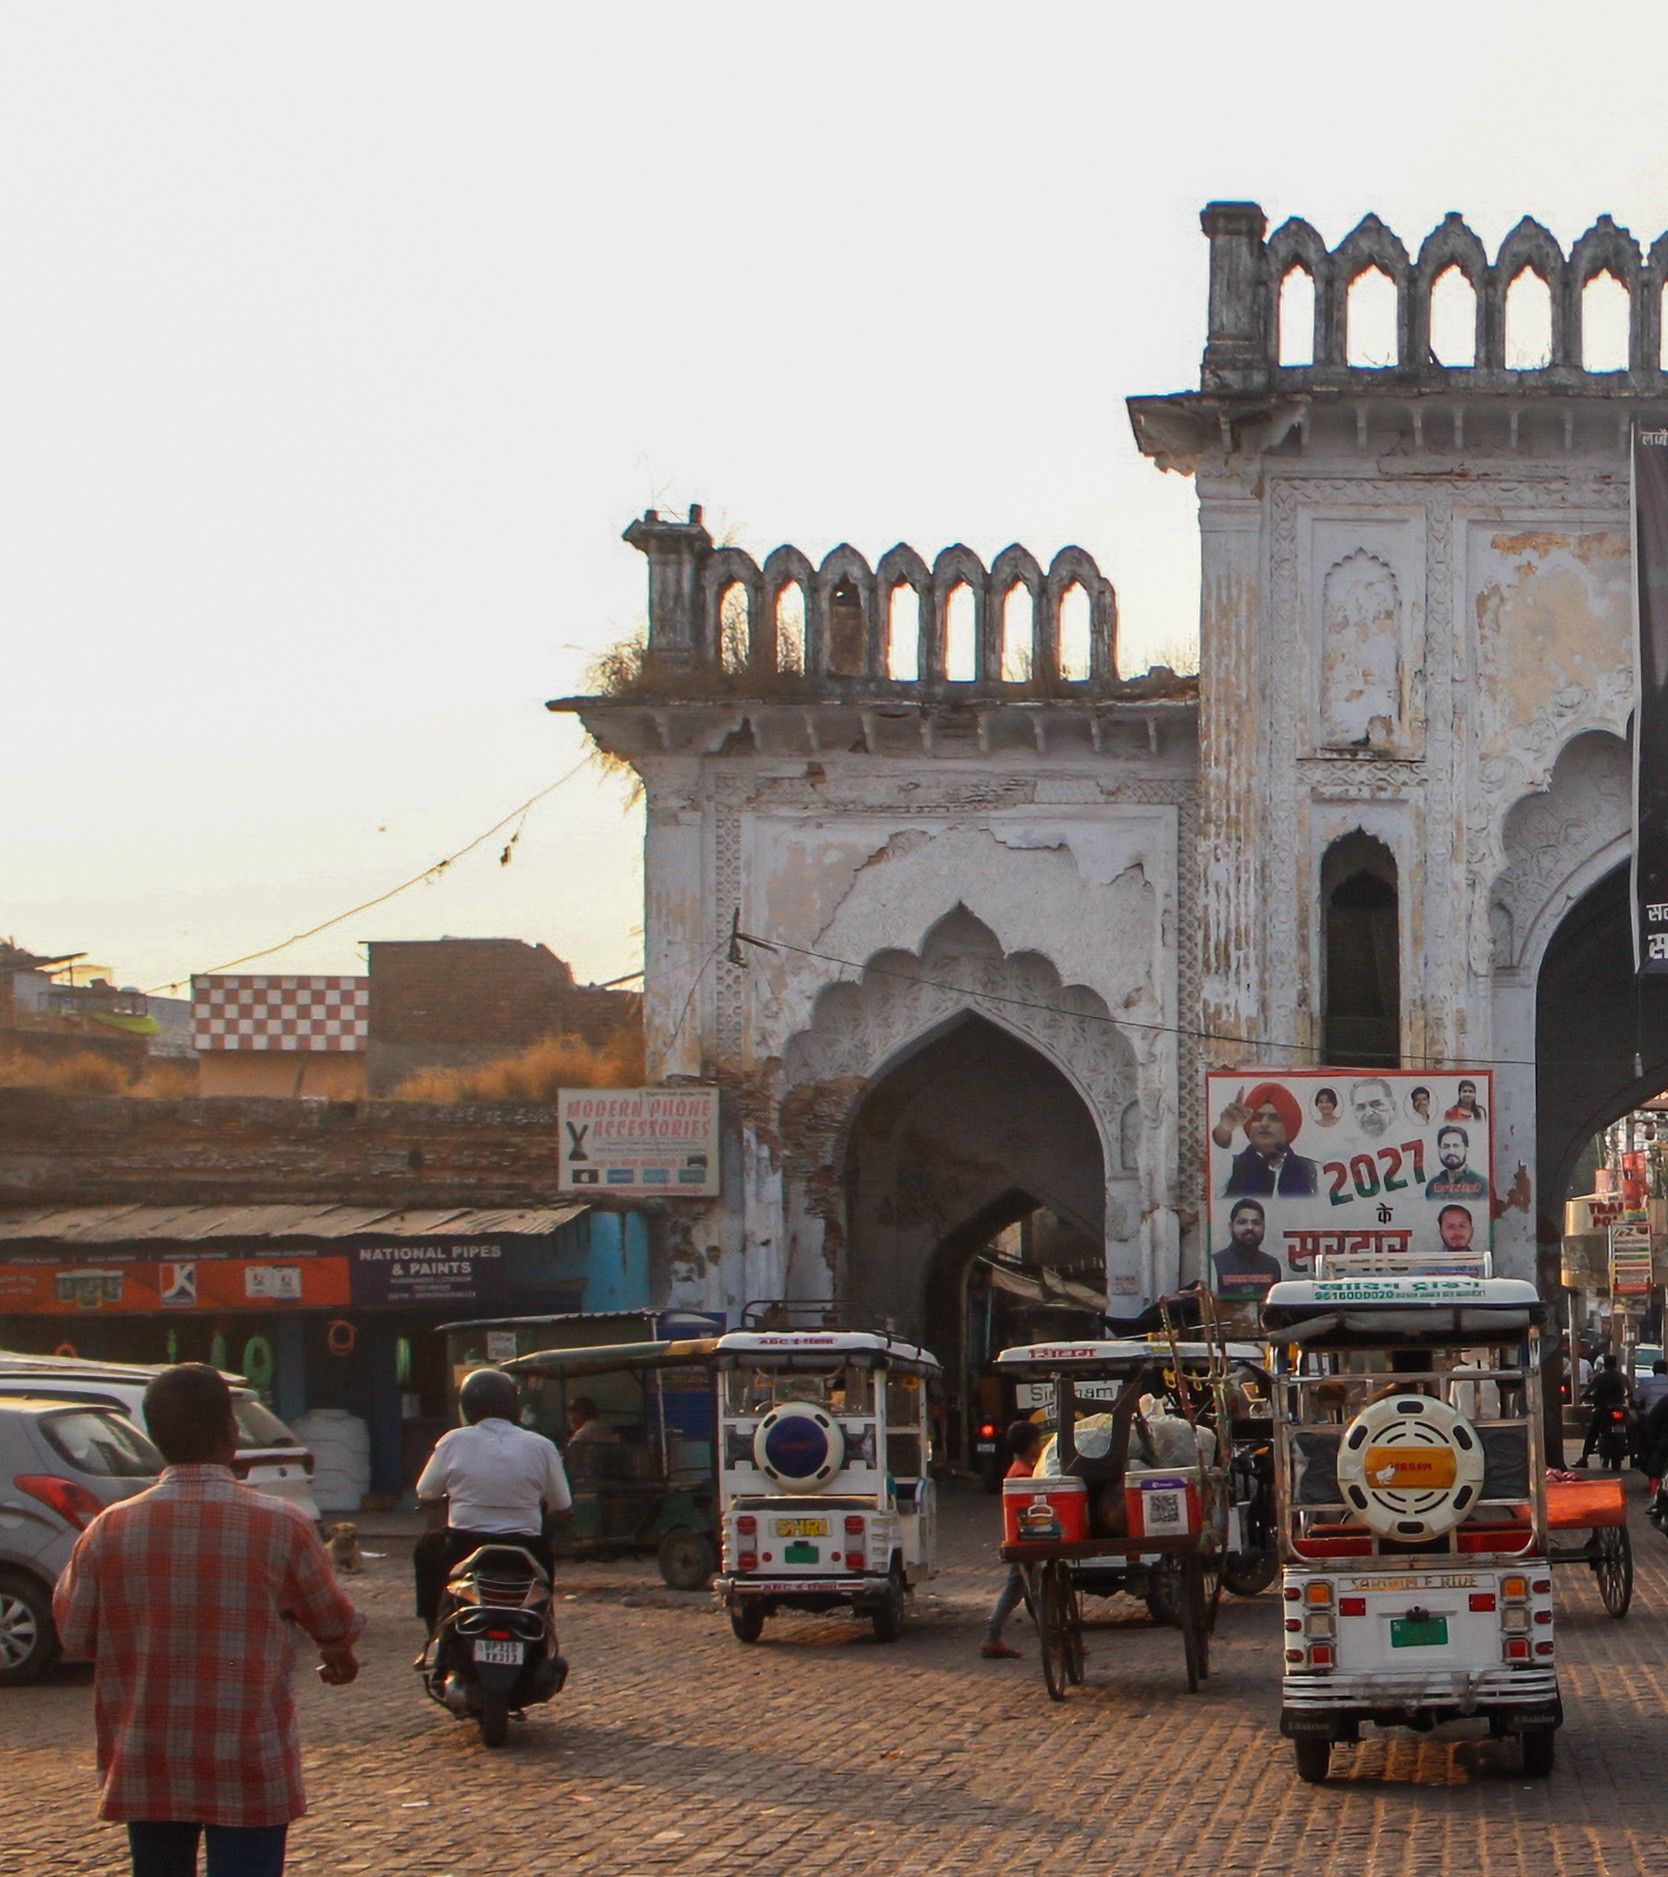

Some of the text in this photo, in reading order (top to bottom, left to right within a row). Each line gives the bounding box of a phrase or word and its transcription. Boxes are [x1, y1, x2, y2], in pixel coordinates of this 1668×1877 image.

[567, 1099, 711, 1118] MODERN PHONE
[593, 1119, 711, 1137] ACCESSORIES
[1323, 1139, 1426, 1206] 2027
[1376, 1202, 1394, 1224] के
[360, 1245, 502, 1260] NATIONAL PIPES
[392, 1261, 472, 1276] & PAINTS
